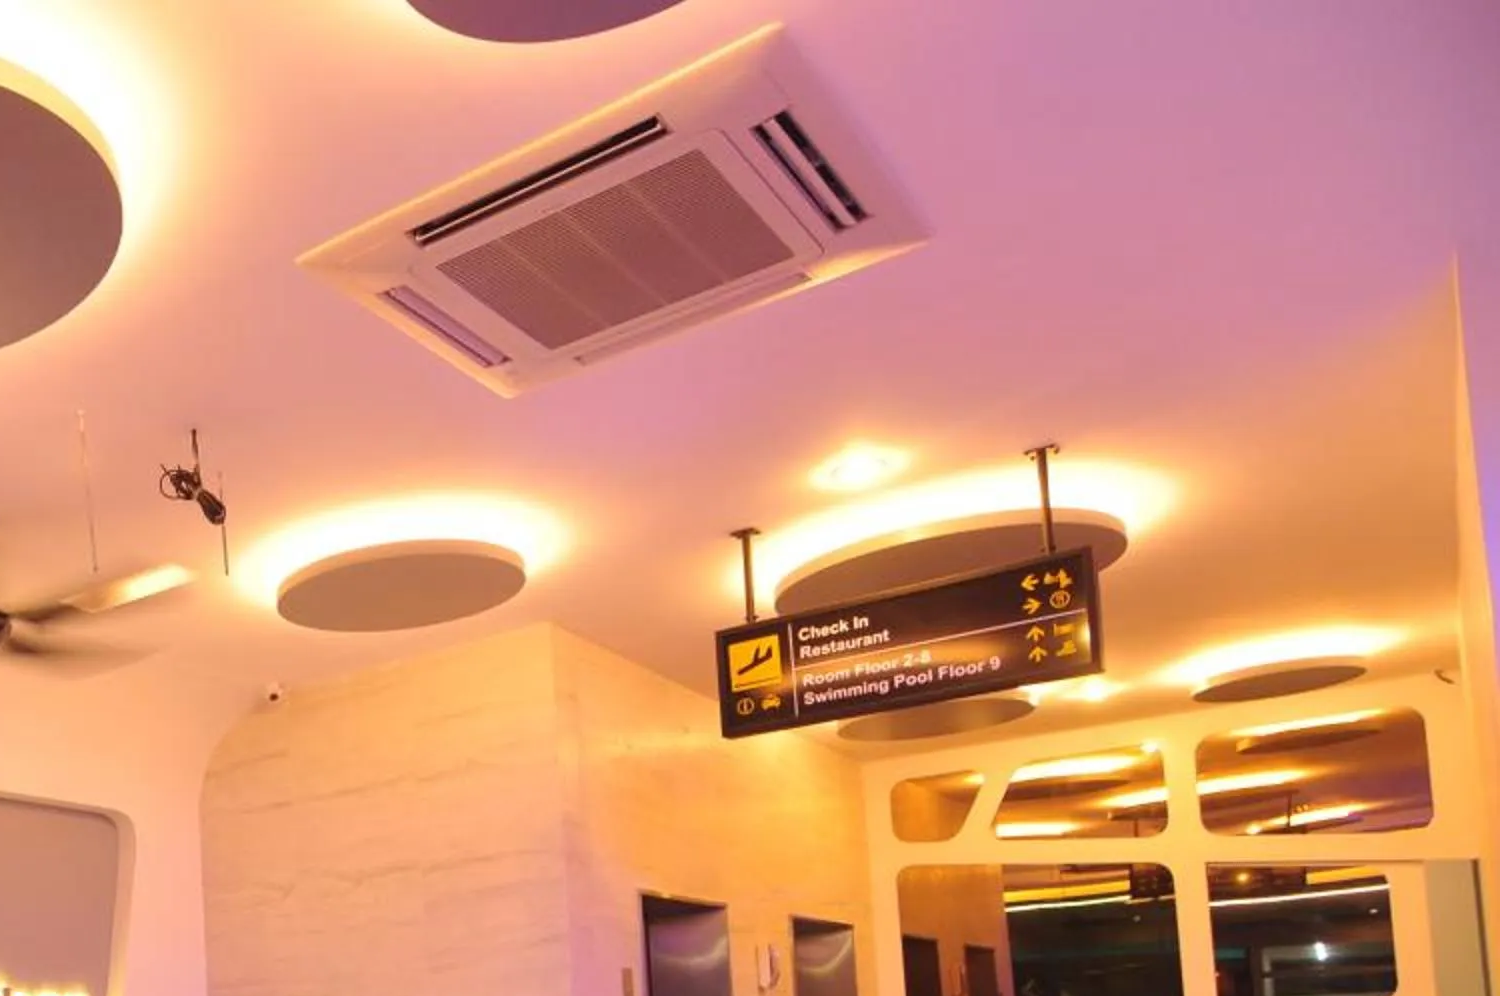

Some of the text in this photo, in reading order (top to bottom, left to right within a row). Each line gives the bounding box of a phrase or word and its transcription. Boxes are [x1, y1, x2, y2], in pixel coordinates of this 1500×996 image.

[798, 616, 869, 642] Check In
[800, 629, 891, 659] Restaurant
[803, 649, 932, 687] Room Floor 2-8
[803, 655, 1001, 705] Swimming Pool Floor 9
